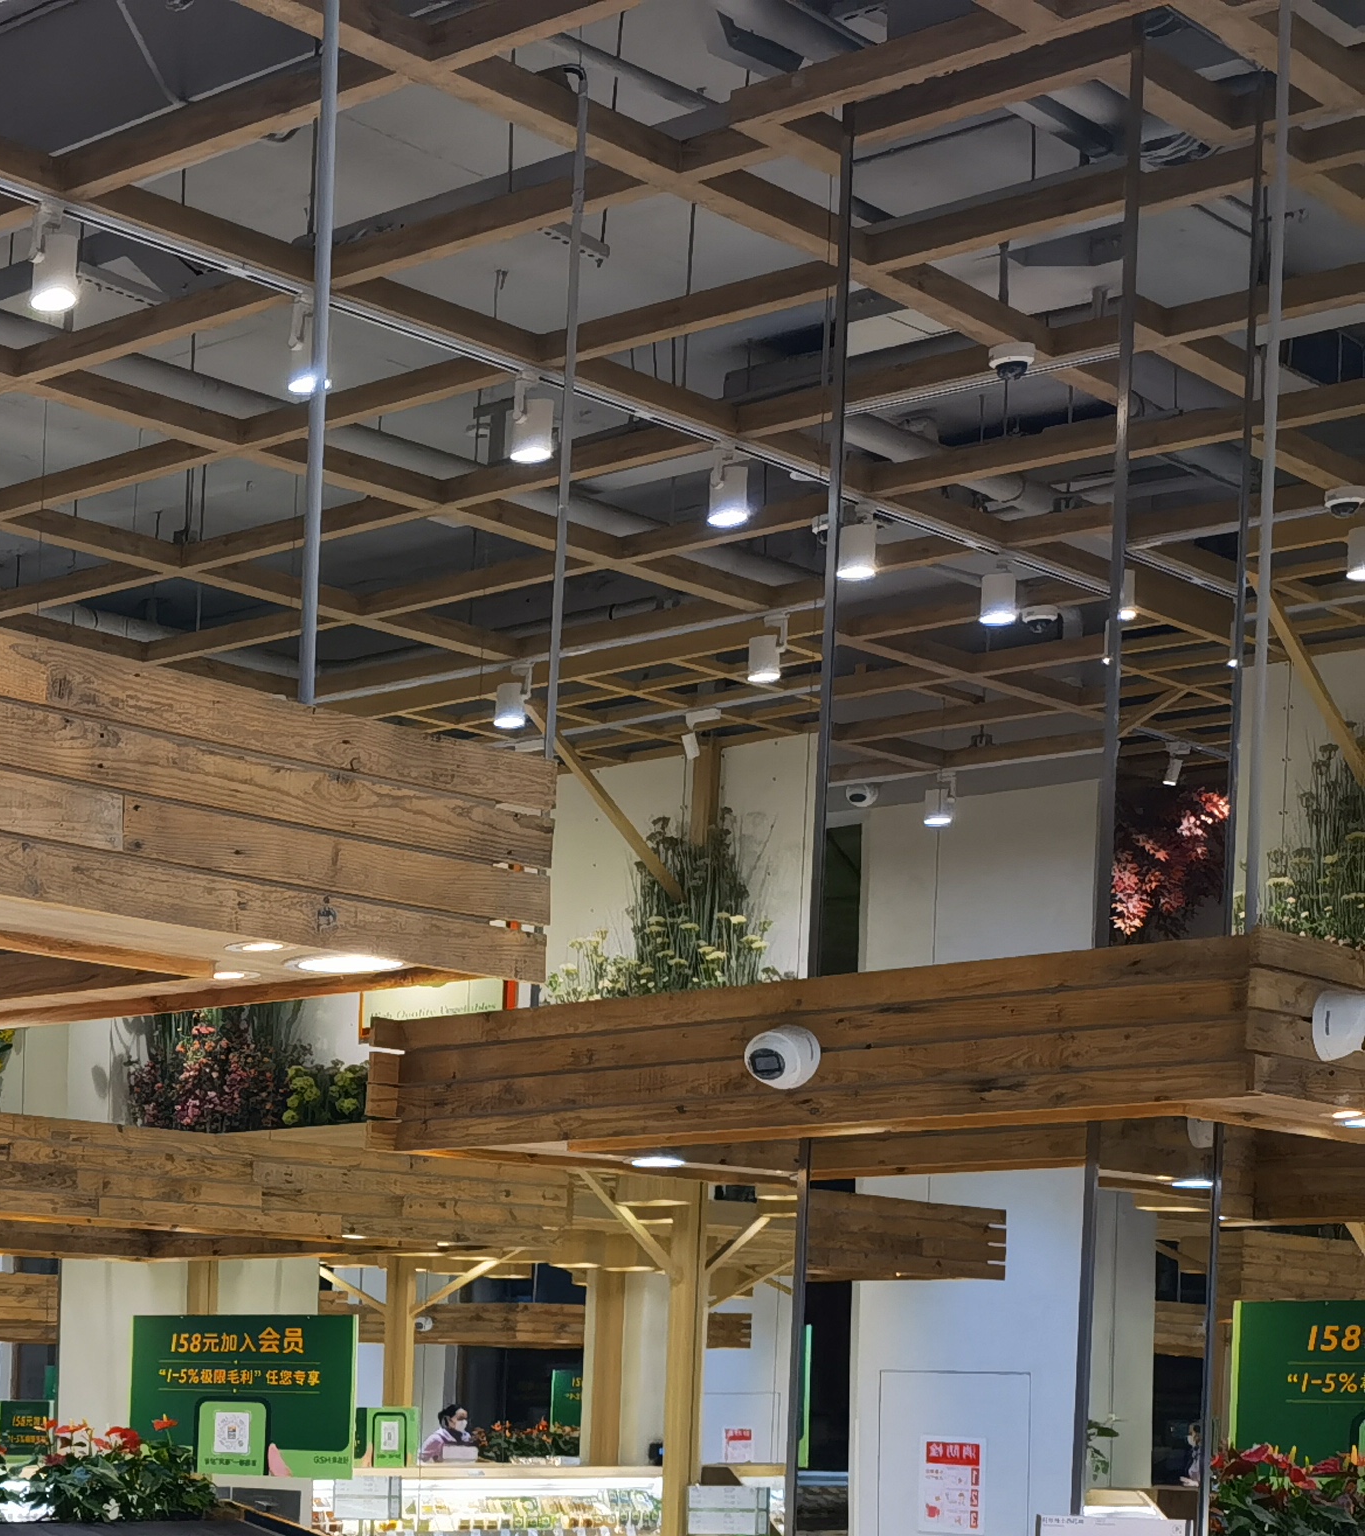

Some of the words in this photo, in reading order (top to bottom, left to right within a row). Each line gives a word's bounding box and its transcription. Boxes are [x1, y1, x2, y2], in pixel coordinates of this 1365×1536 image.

[170, 1326, 304, 1354] 158元加入会员
[1307, 1324, 1365, 1351] 158
[265, 1369, 321, 1387] 任您专享
